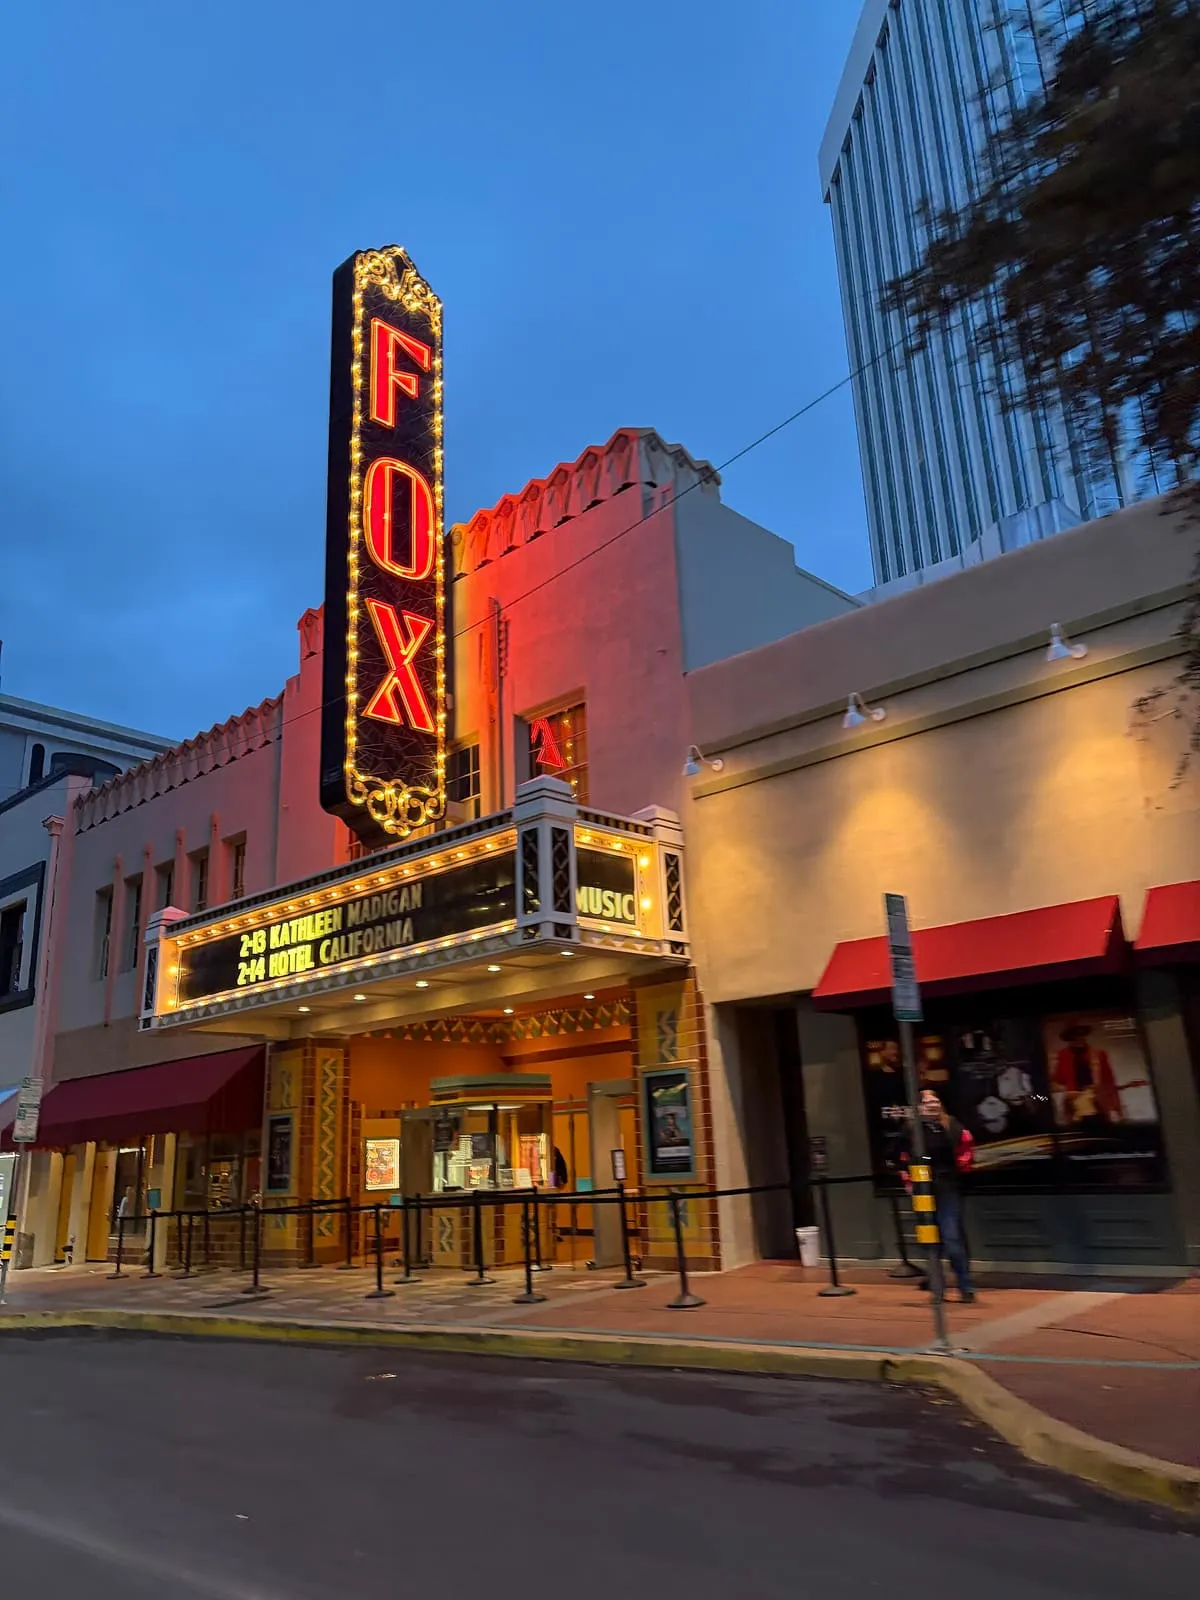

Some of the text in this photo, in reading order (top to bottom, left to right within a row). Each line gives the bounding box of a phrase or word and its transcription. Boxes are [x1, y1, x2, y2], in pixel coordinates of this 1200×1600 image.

[361, 316, 436, 734] FOX
[240, 883, 422, 958] 2-13 KATHLEEN MADIGAN
[575, 886, 636, 921] MUSIC
[237, 917, 414, 985] 2-14 HOTEL CALIFORNIA
